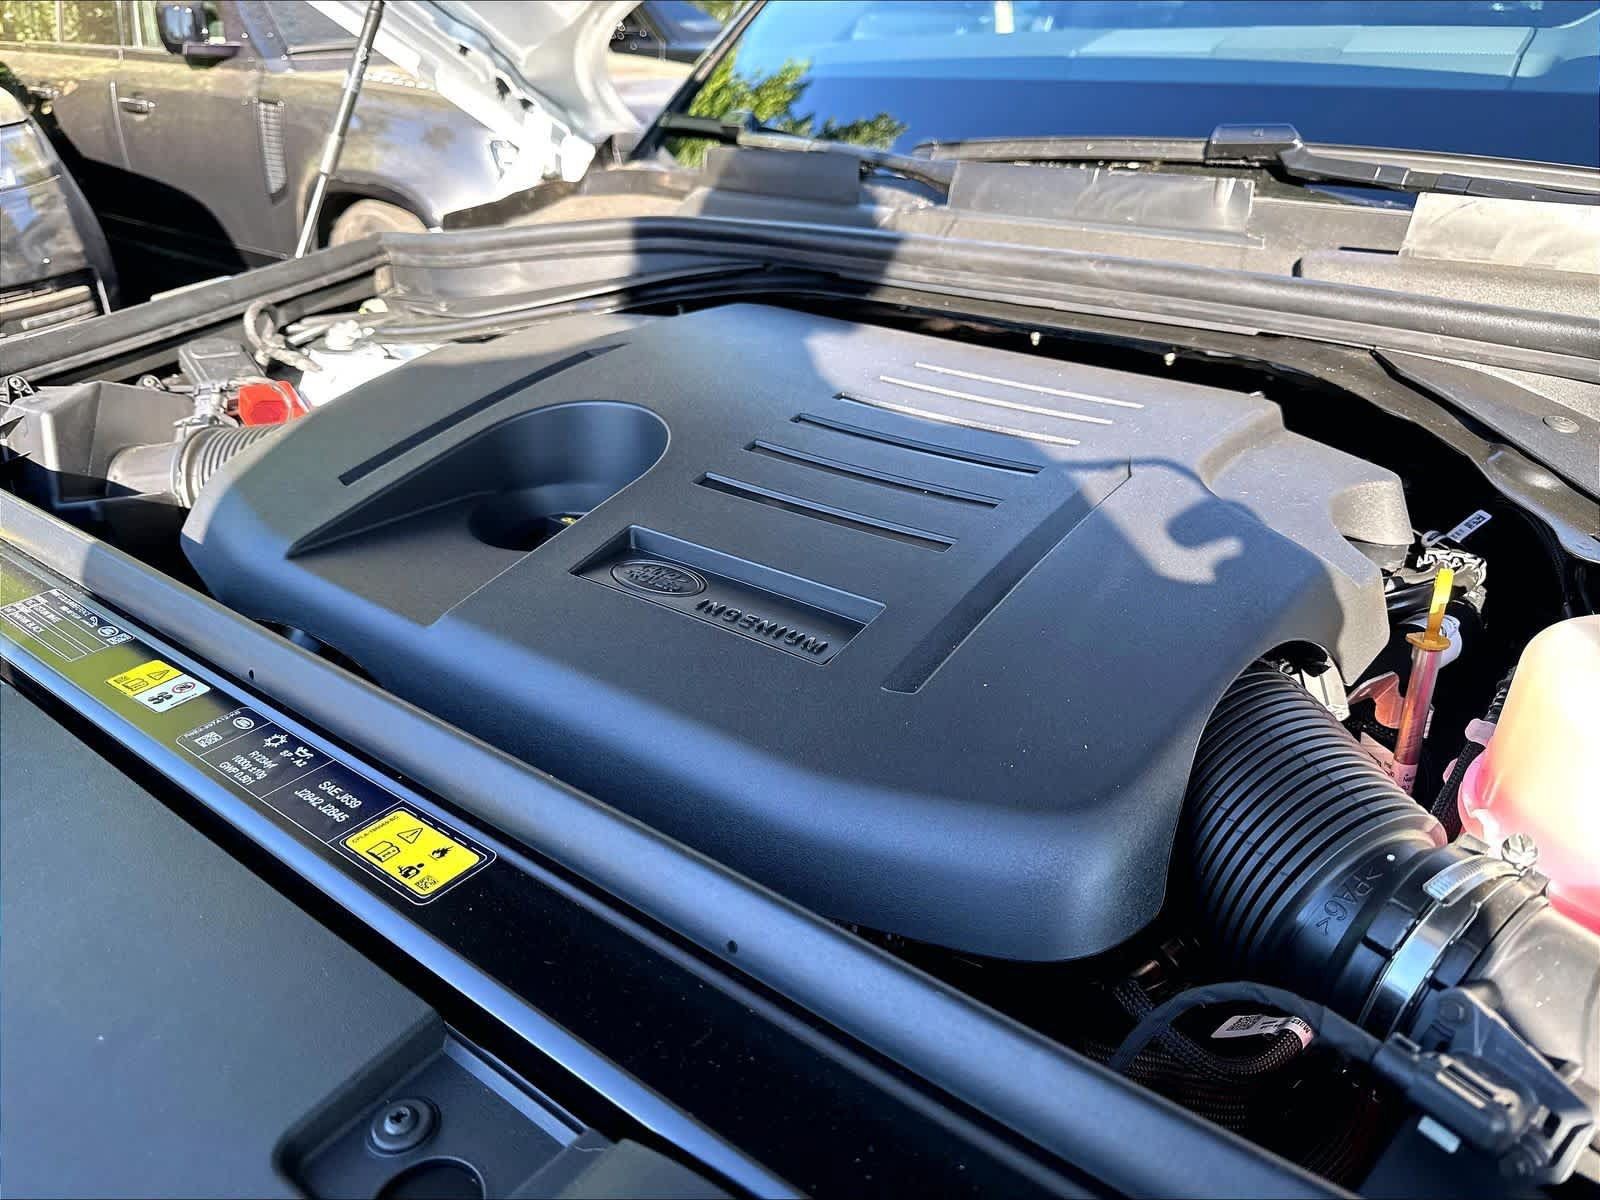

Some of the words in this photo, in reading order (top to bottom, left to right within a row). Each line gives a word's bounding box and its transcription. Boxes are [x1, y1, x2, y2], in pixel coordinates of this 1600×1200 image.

[694, 598, 830, 655] INGENIUM
[218, 761, 239, 776] GWP
[293, 757, 308, 768] A2
[294, 788, 322, 808] J2842
[318, 803, 349, 824] J2845
[319, 781, 342, 797] SAE
[336, 791, 362, 810] J639
